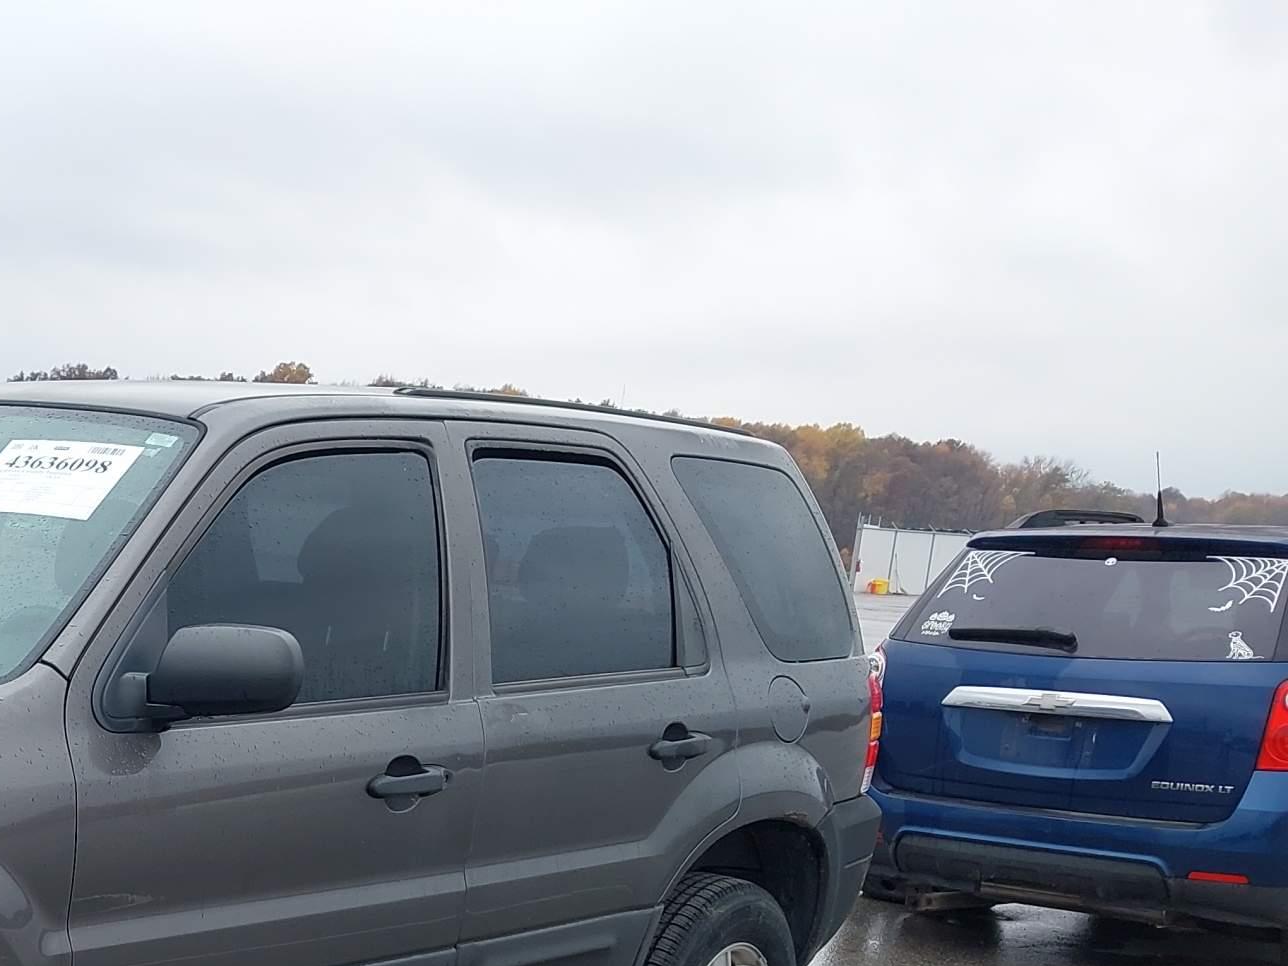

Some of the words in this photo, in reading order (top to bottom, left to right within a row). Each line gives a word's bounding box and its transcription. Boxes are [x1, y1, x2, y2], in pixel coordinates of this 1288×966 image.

[4, 455, 113, 474] 43636098
[1151, 780, 1215, 793] EQUINOX
[1218, 785, 1235, 794] LT
